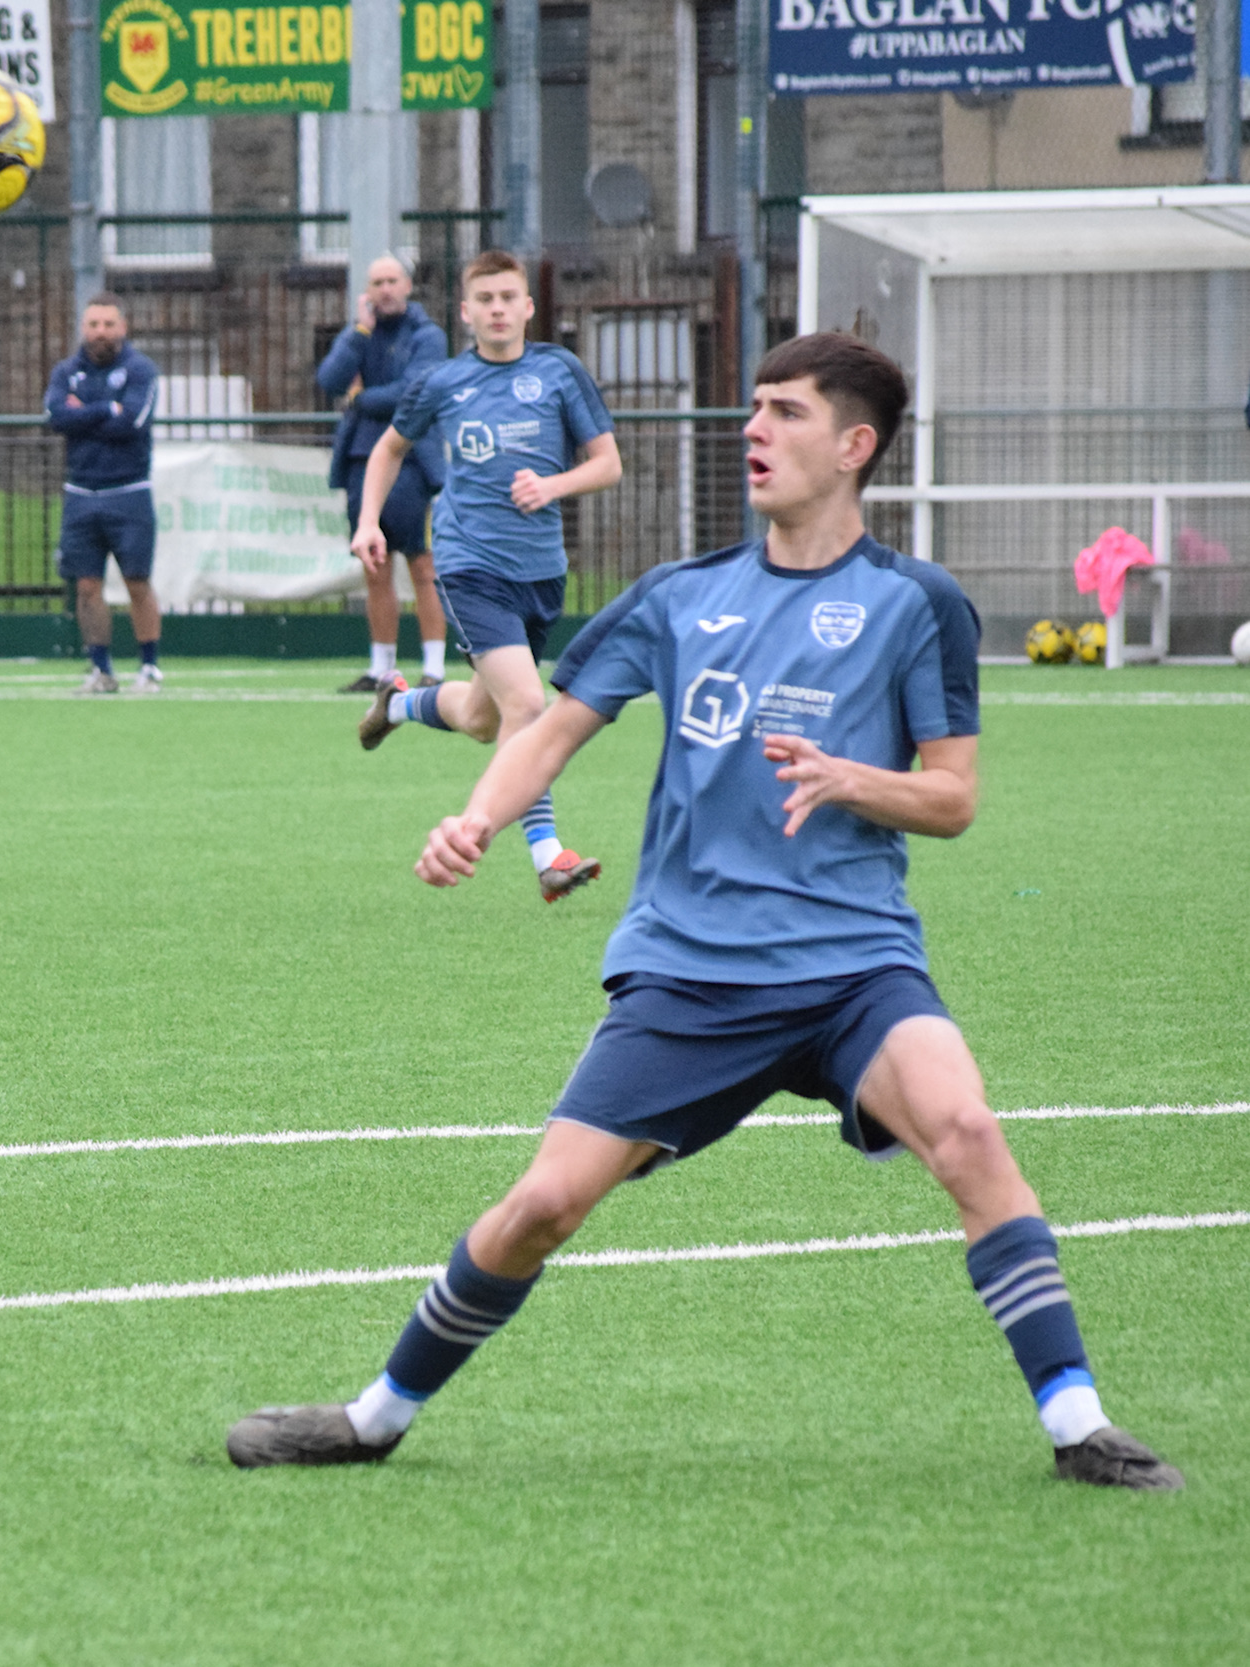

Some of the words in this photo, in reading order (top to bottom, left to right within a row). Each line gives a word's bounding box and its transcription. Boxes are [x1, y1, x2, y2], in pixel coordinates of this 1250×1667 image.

[20, 10, 38, 41] &
[190, 4, 405, 67] TREHERB
[414, 1, 484, 61] BGC
[849, 28, 1026, 60] #UPPABAGLAN
